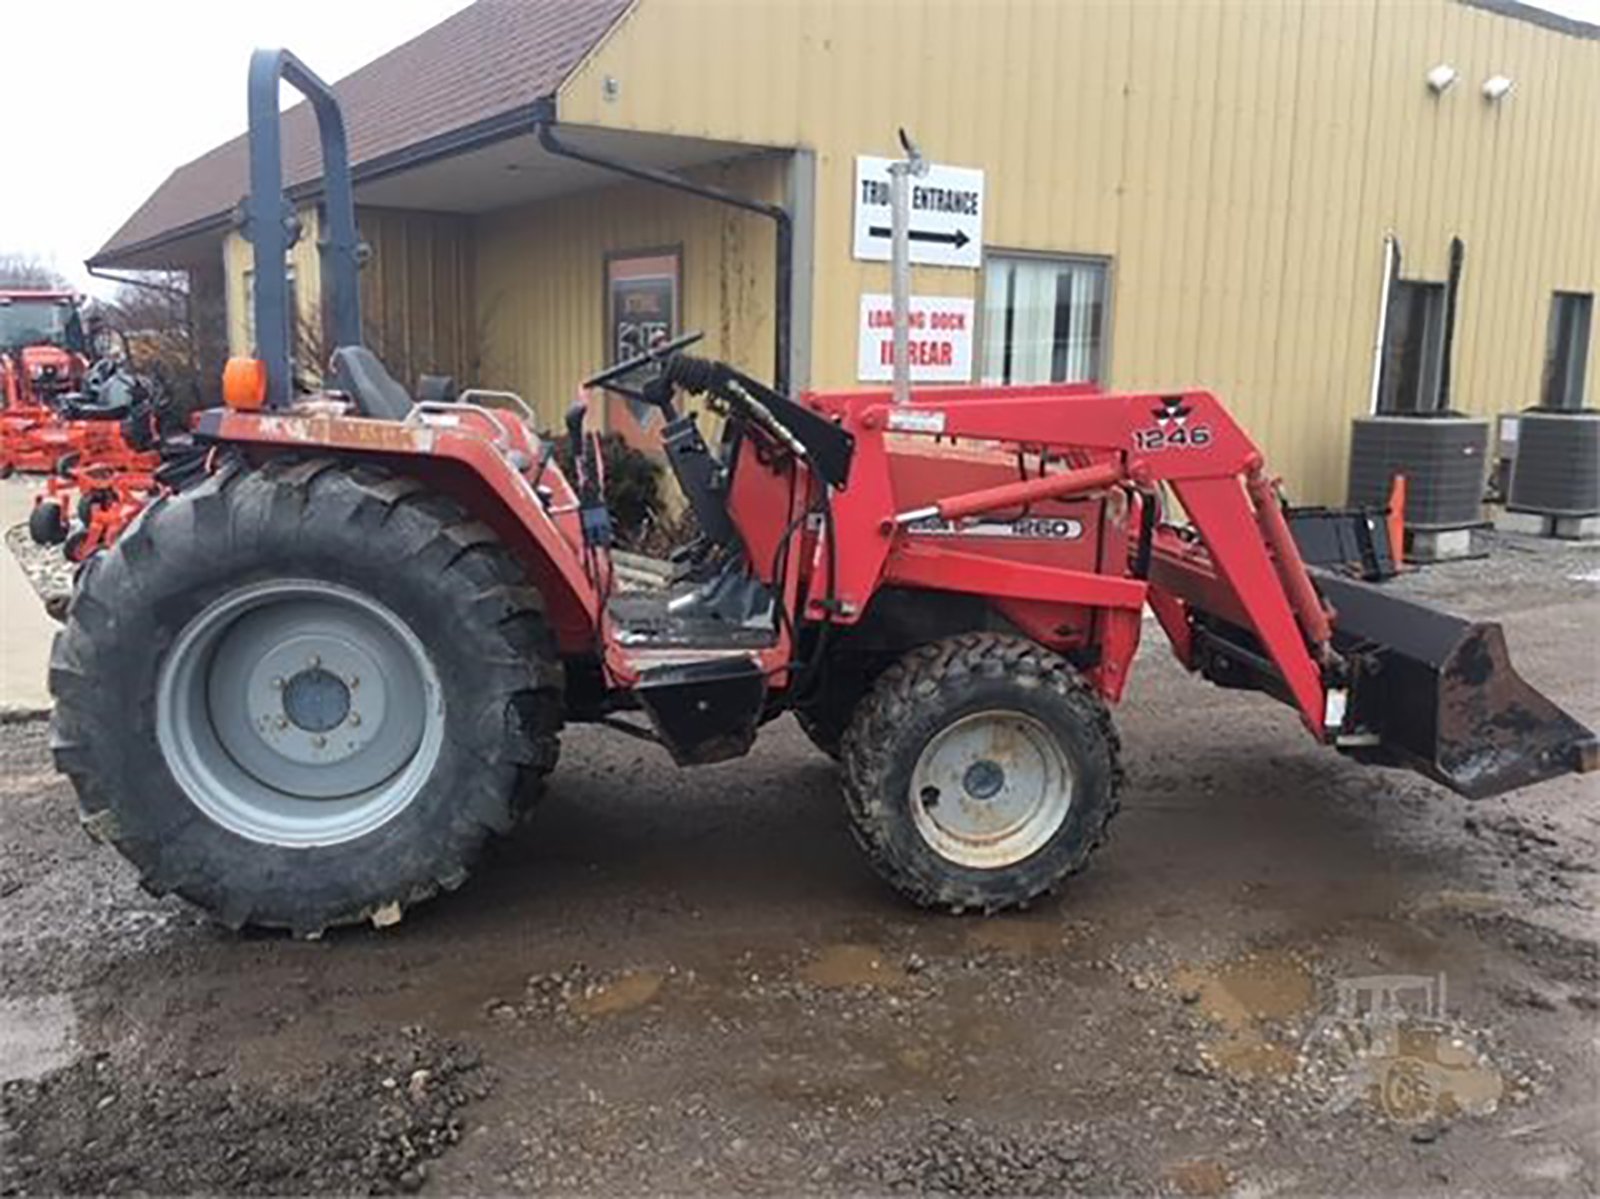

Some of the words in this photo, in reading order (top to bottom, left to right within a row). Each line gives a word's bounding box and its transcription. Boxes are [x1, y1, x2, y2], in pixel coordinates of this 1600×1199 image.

[861, 179, 898, 207] TRU
[912, 186, 979, 216] ENTRANCE
[868, 309, 925, 329] LOANG
[930, 312, 966, 331] DOCK
[1132, 425, 1212, 450] 1246
[1010, 518, 1070, 538] 1260
